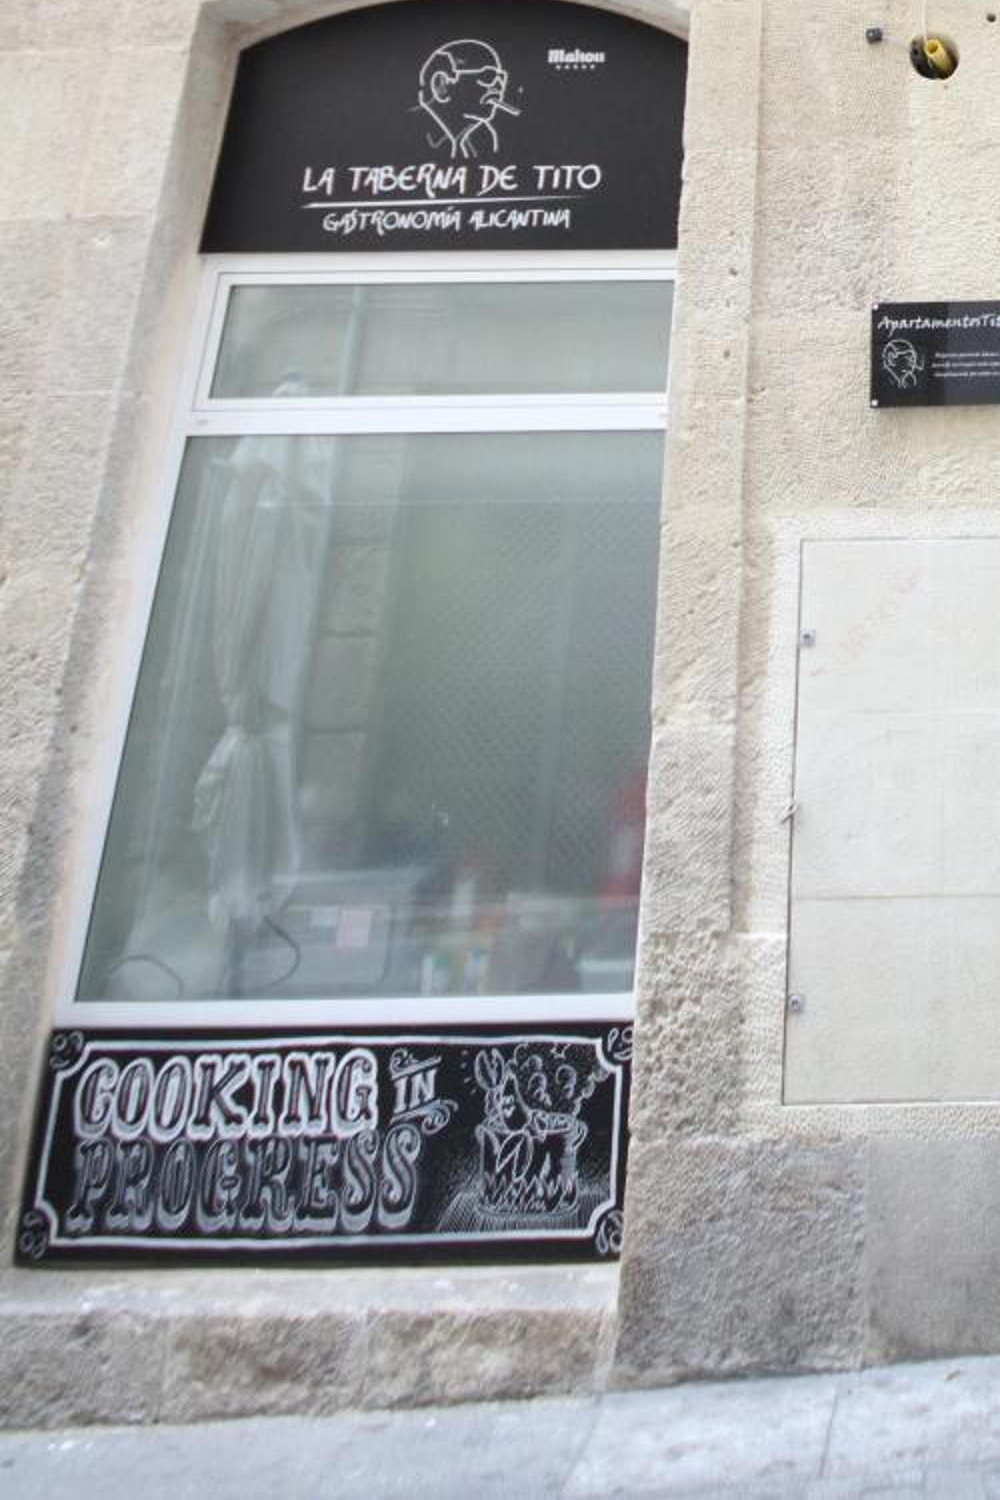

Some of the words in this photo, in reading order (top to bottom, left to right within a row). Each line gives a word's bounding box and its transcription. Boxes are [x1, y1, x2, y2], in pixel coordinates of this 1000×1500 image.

[548, 48, 605, 63] Mahou
[302, 166, 335, 195] LA
[348, 163, 467, 198] TABERNA
[476, 165, 518, 196] DE
[533, 164, 602, 190] TITO
[468, 209, 570, 231] ALICANTINA
[74, 1048, 379, 1143] COOKING
[393, 1068, 437, 1114] IN
[64, 1124, 422, 1234] PROGRESS
